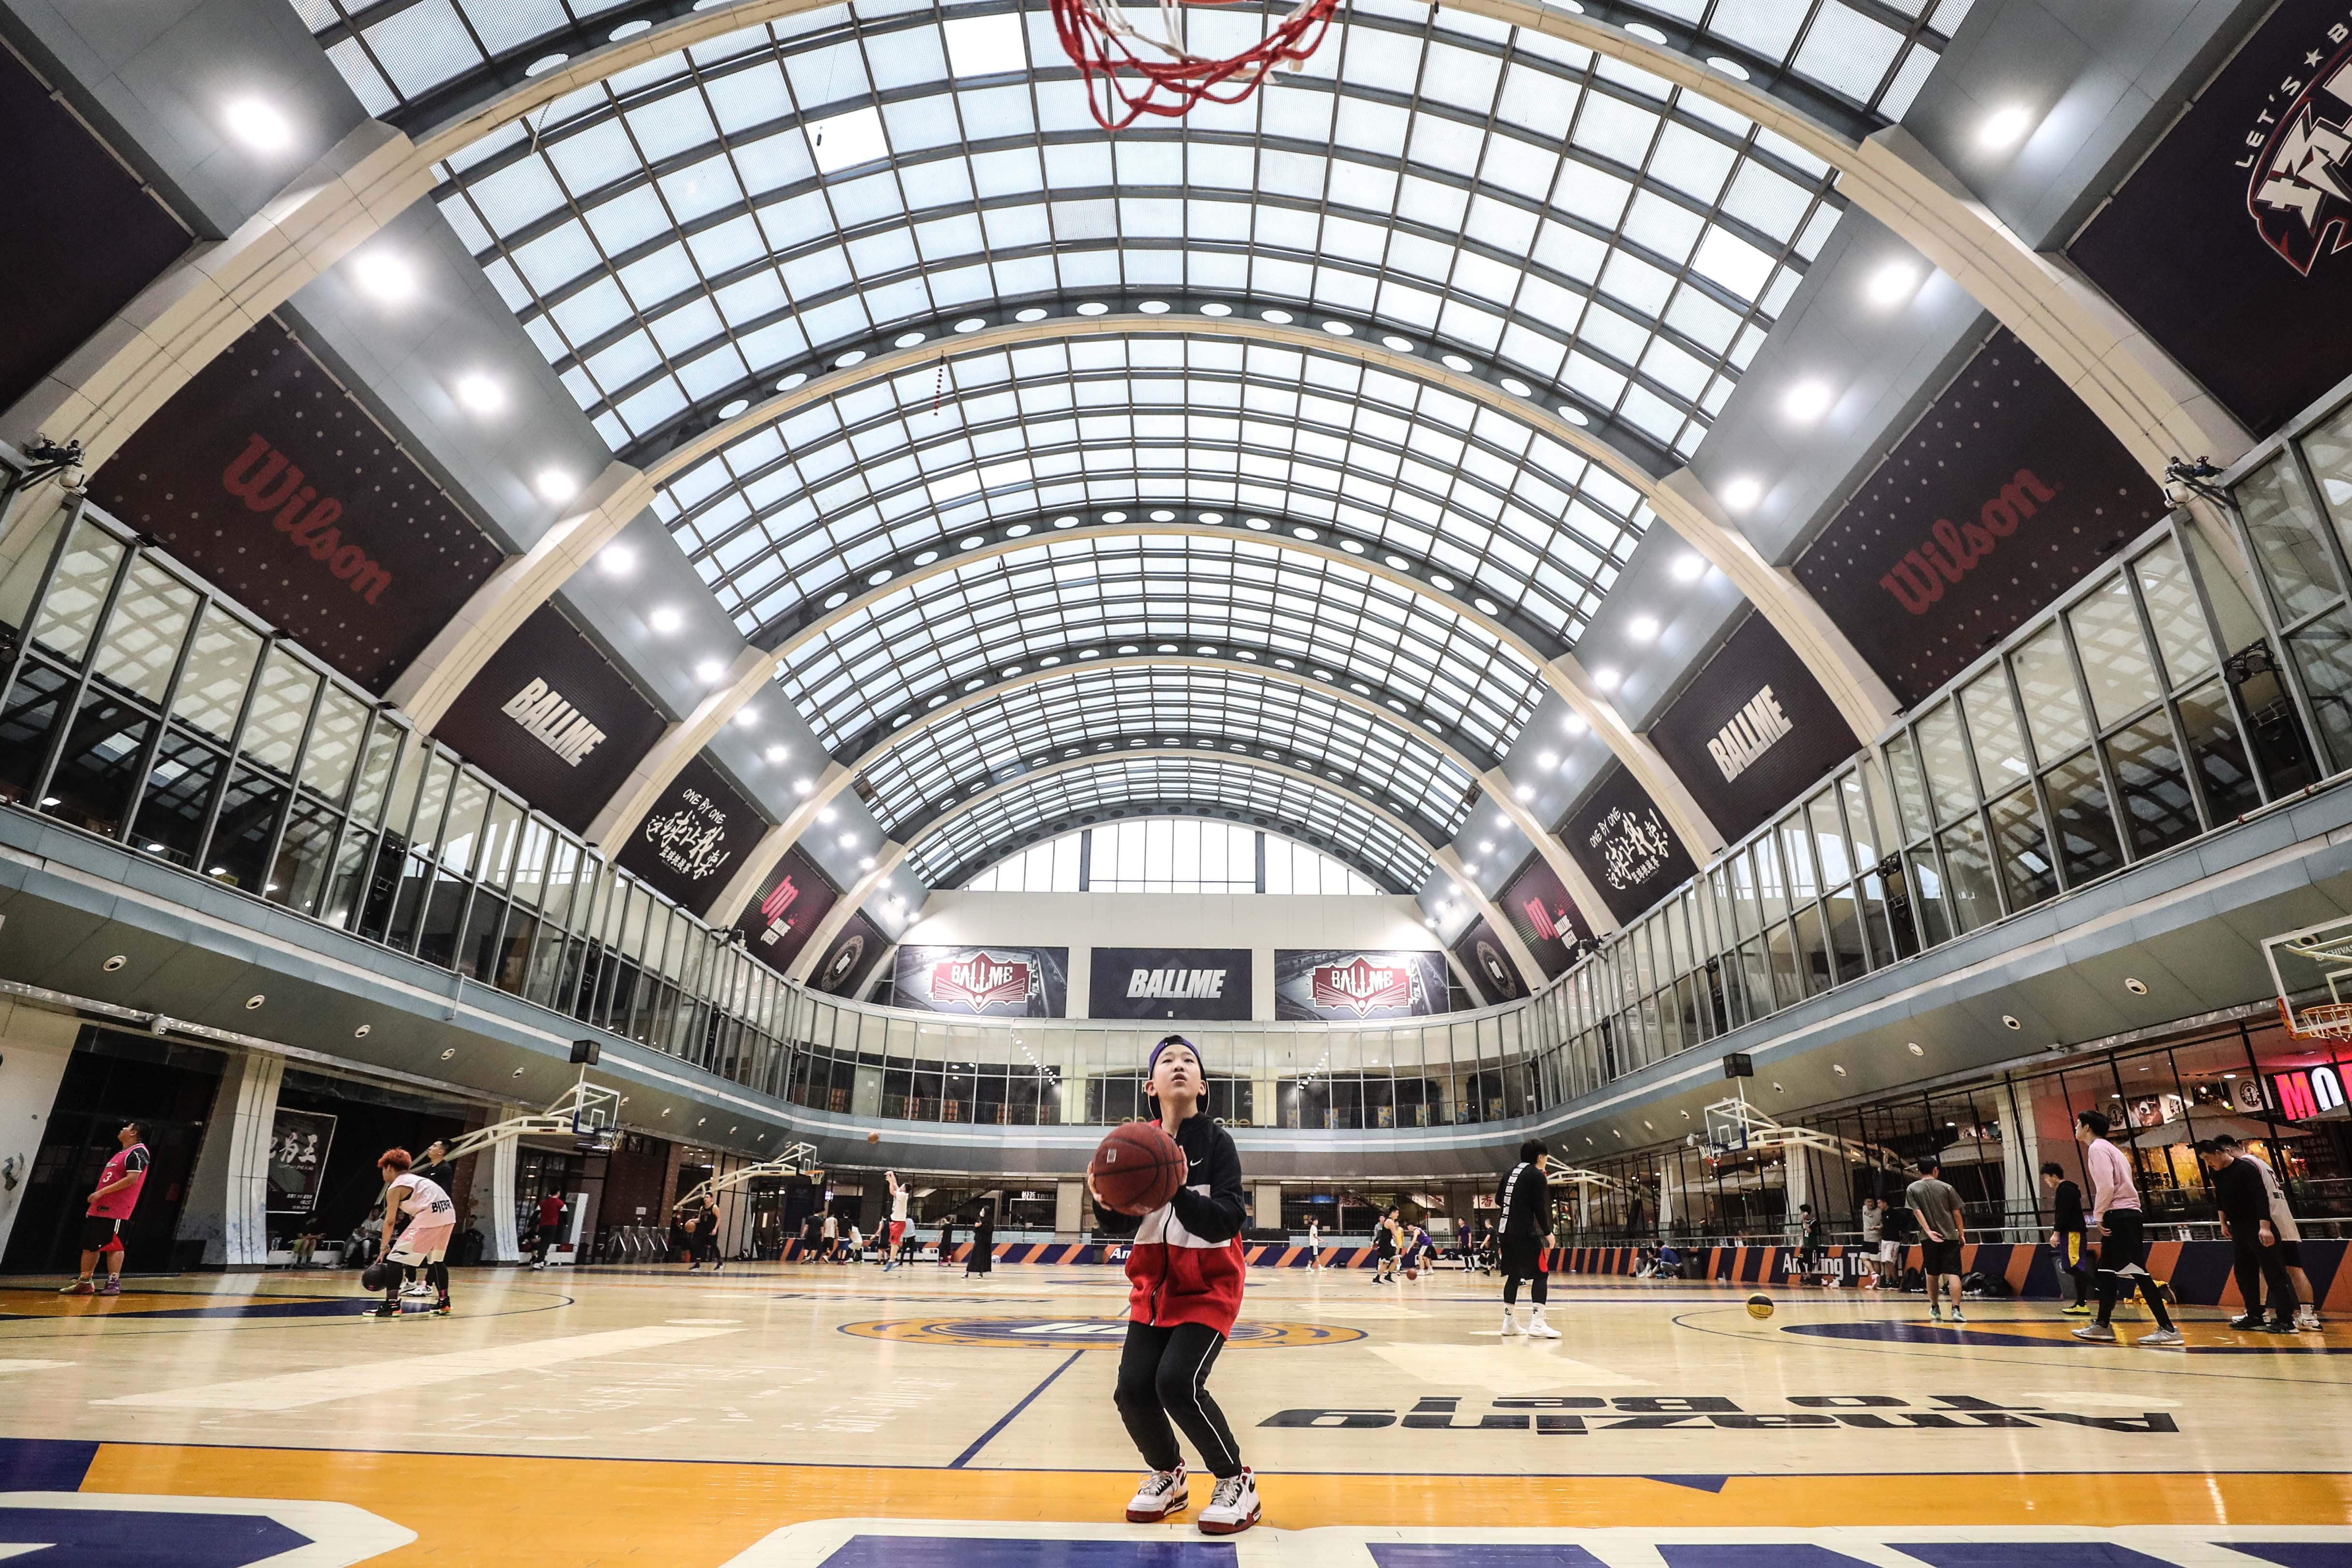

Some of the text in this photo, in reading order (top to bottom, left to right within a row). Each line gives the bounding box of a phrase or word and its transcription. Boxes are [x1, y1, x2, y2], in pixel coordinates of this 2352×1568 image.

[2235, 75, 2301, 169] LET'S
[221, 432, 392, 604] Wilson
[1879, 468, 2057, 614] Wilson
[501, 677, 606, 767] BALLME
[1707, 685, 1793, 782] BALLME
[682, 789, 726, 824] ONE BY ONE
[1589, 806, 1621, 848] ONE BY ONE
[951, 962, 1013, 993] BALLME
[1127, 969, 1227, 998] BALLME
[1331, 966, 1393, 998] BALLME
[102, 1171, 113, 1183] 3
[1411, 1395, 2044, 1413] To Be!
[1256, 1409, 2179, 1435] Amazing
